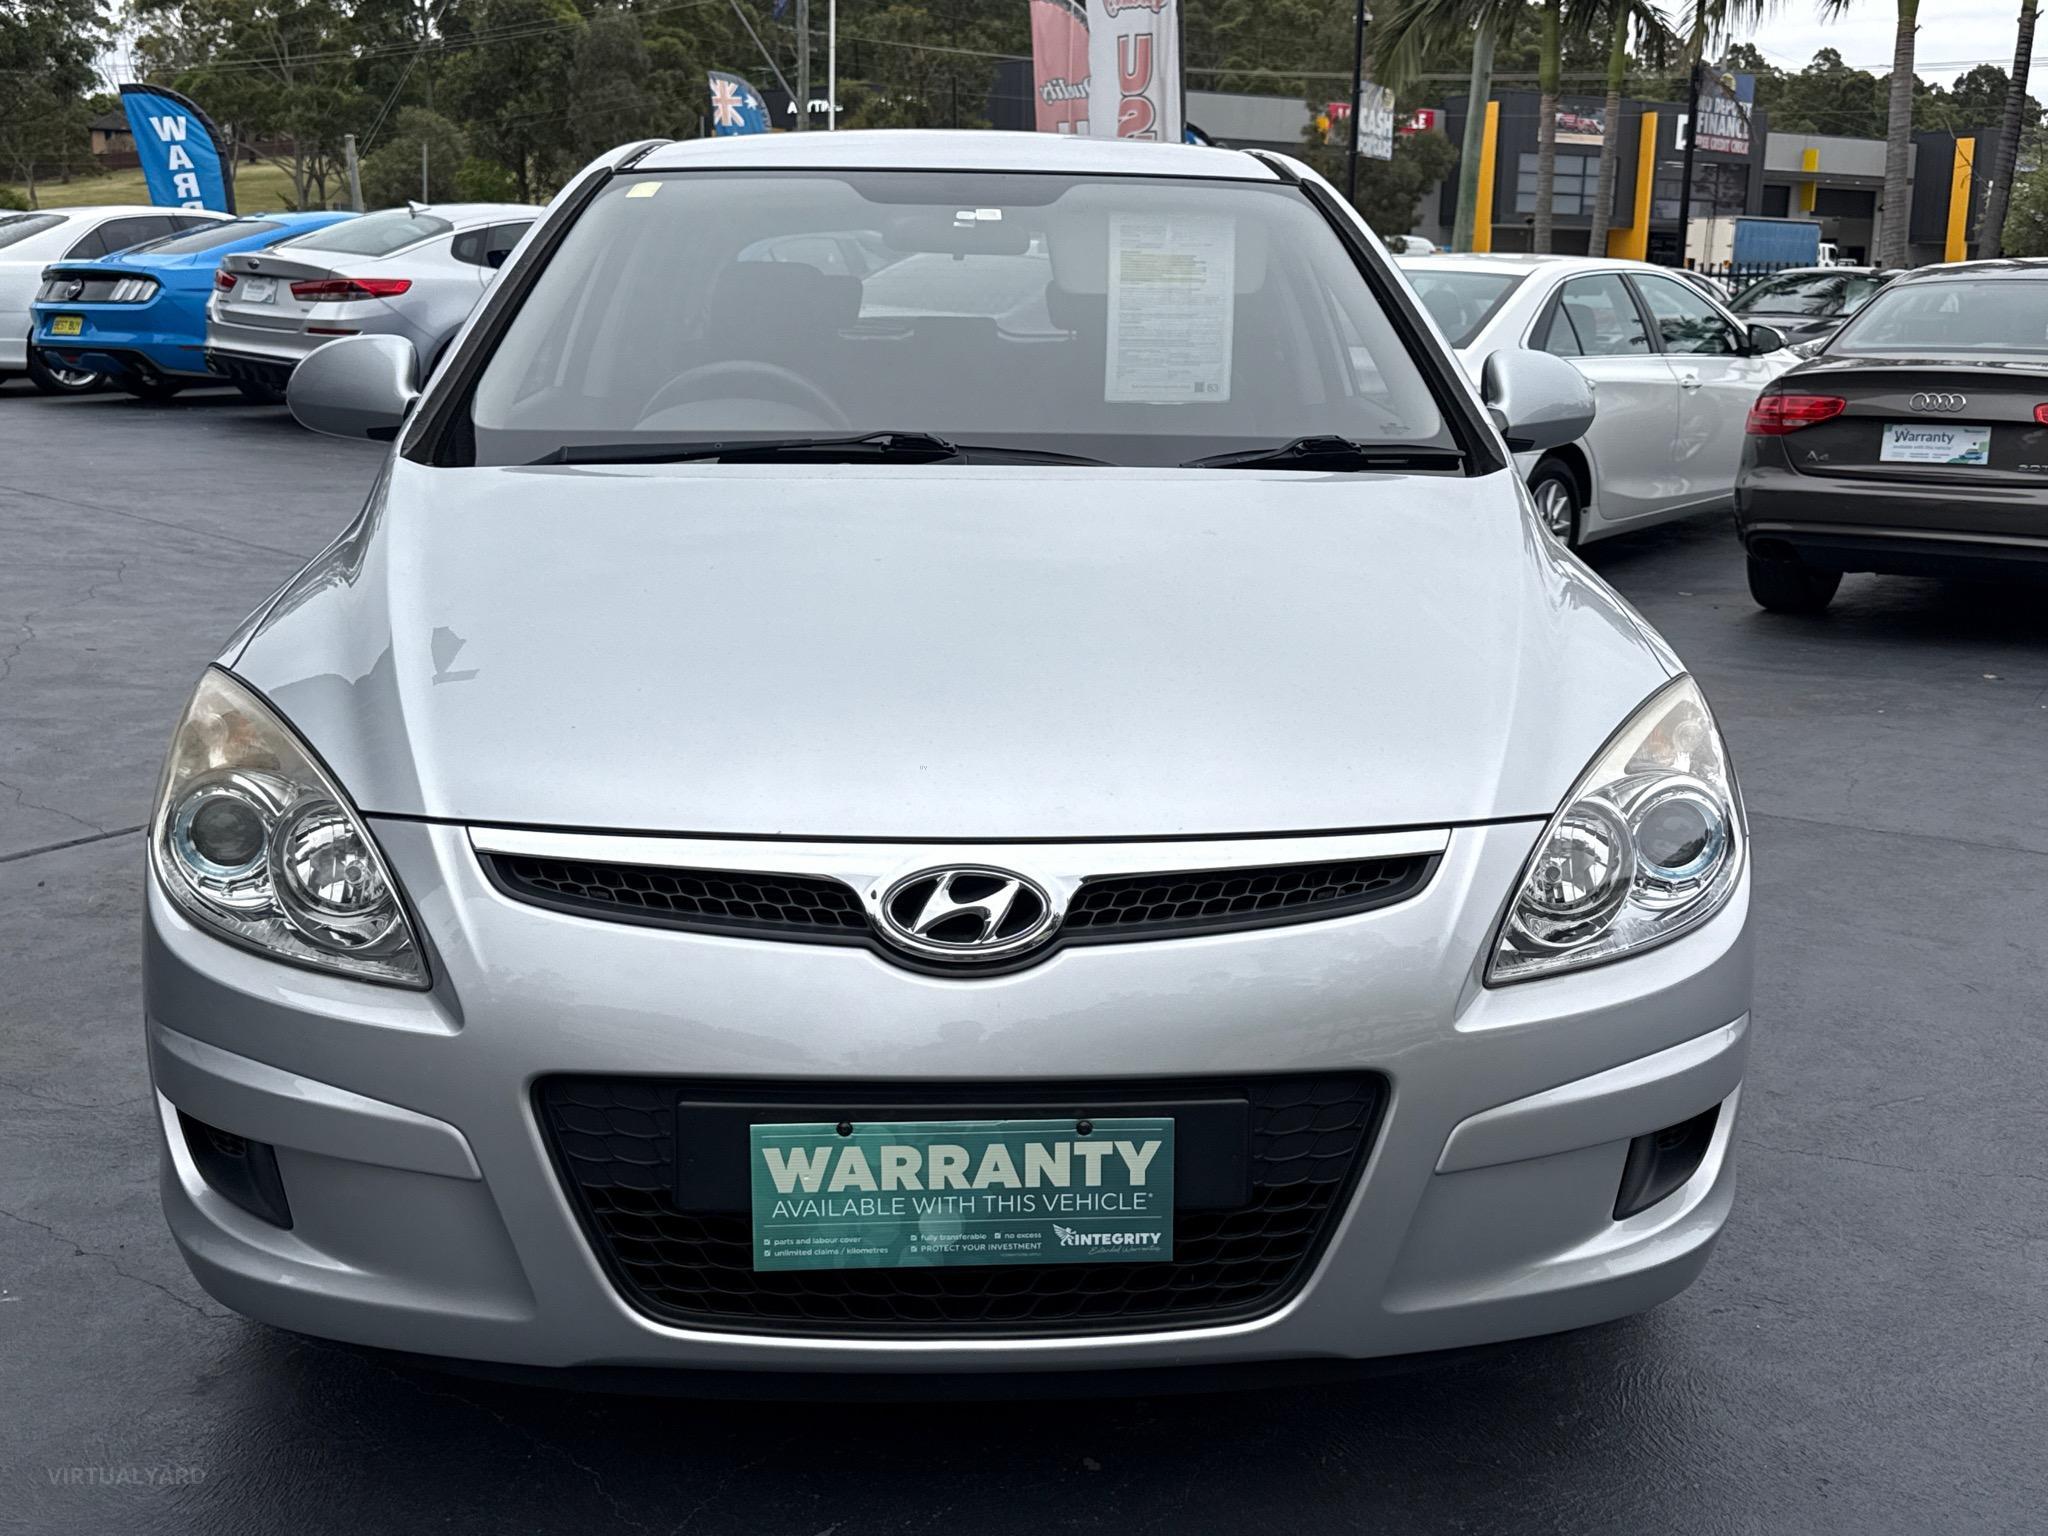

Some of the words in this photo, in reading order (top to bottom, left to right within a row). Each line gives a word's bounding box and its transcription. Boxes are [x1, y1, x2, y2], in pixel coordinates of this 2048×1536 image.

[1894, 429, 1955, 445] Warranty
[761, 1140, 1162, 1194] WARRANTY
[771, 1197, 906, 1218] AVAILABLE
[912, 1195, 975, 1215] WITH
[982, 1194, 1036, 1213] THIS
[773, 1237, 794, 1247] parts
[795, 1237, 810, 1245] and
[812, 1236, 838, 1244] labour
[839, 1236, 861, 1244] cover
[920, 1233, 938, 1242] fully
[939, 1232, 987, 1241] transferable
[1074, 1232, 1162, 1246] INTEGRITY
[773, 1248, 813, 1257] unlimited
[814, 1247, 839, 1256] claims
[847, 1246, 889, 1254] kilometres
[920, 1244, 960, 1252] PROTECT
[961, 1243, 986, 1251] YOUR
[988, 1242, 1042, 1250] INVESTMENT
